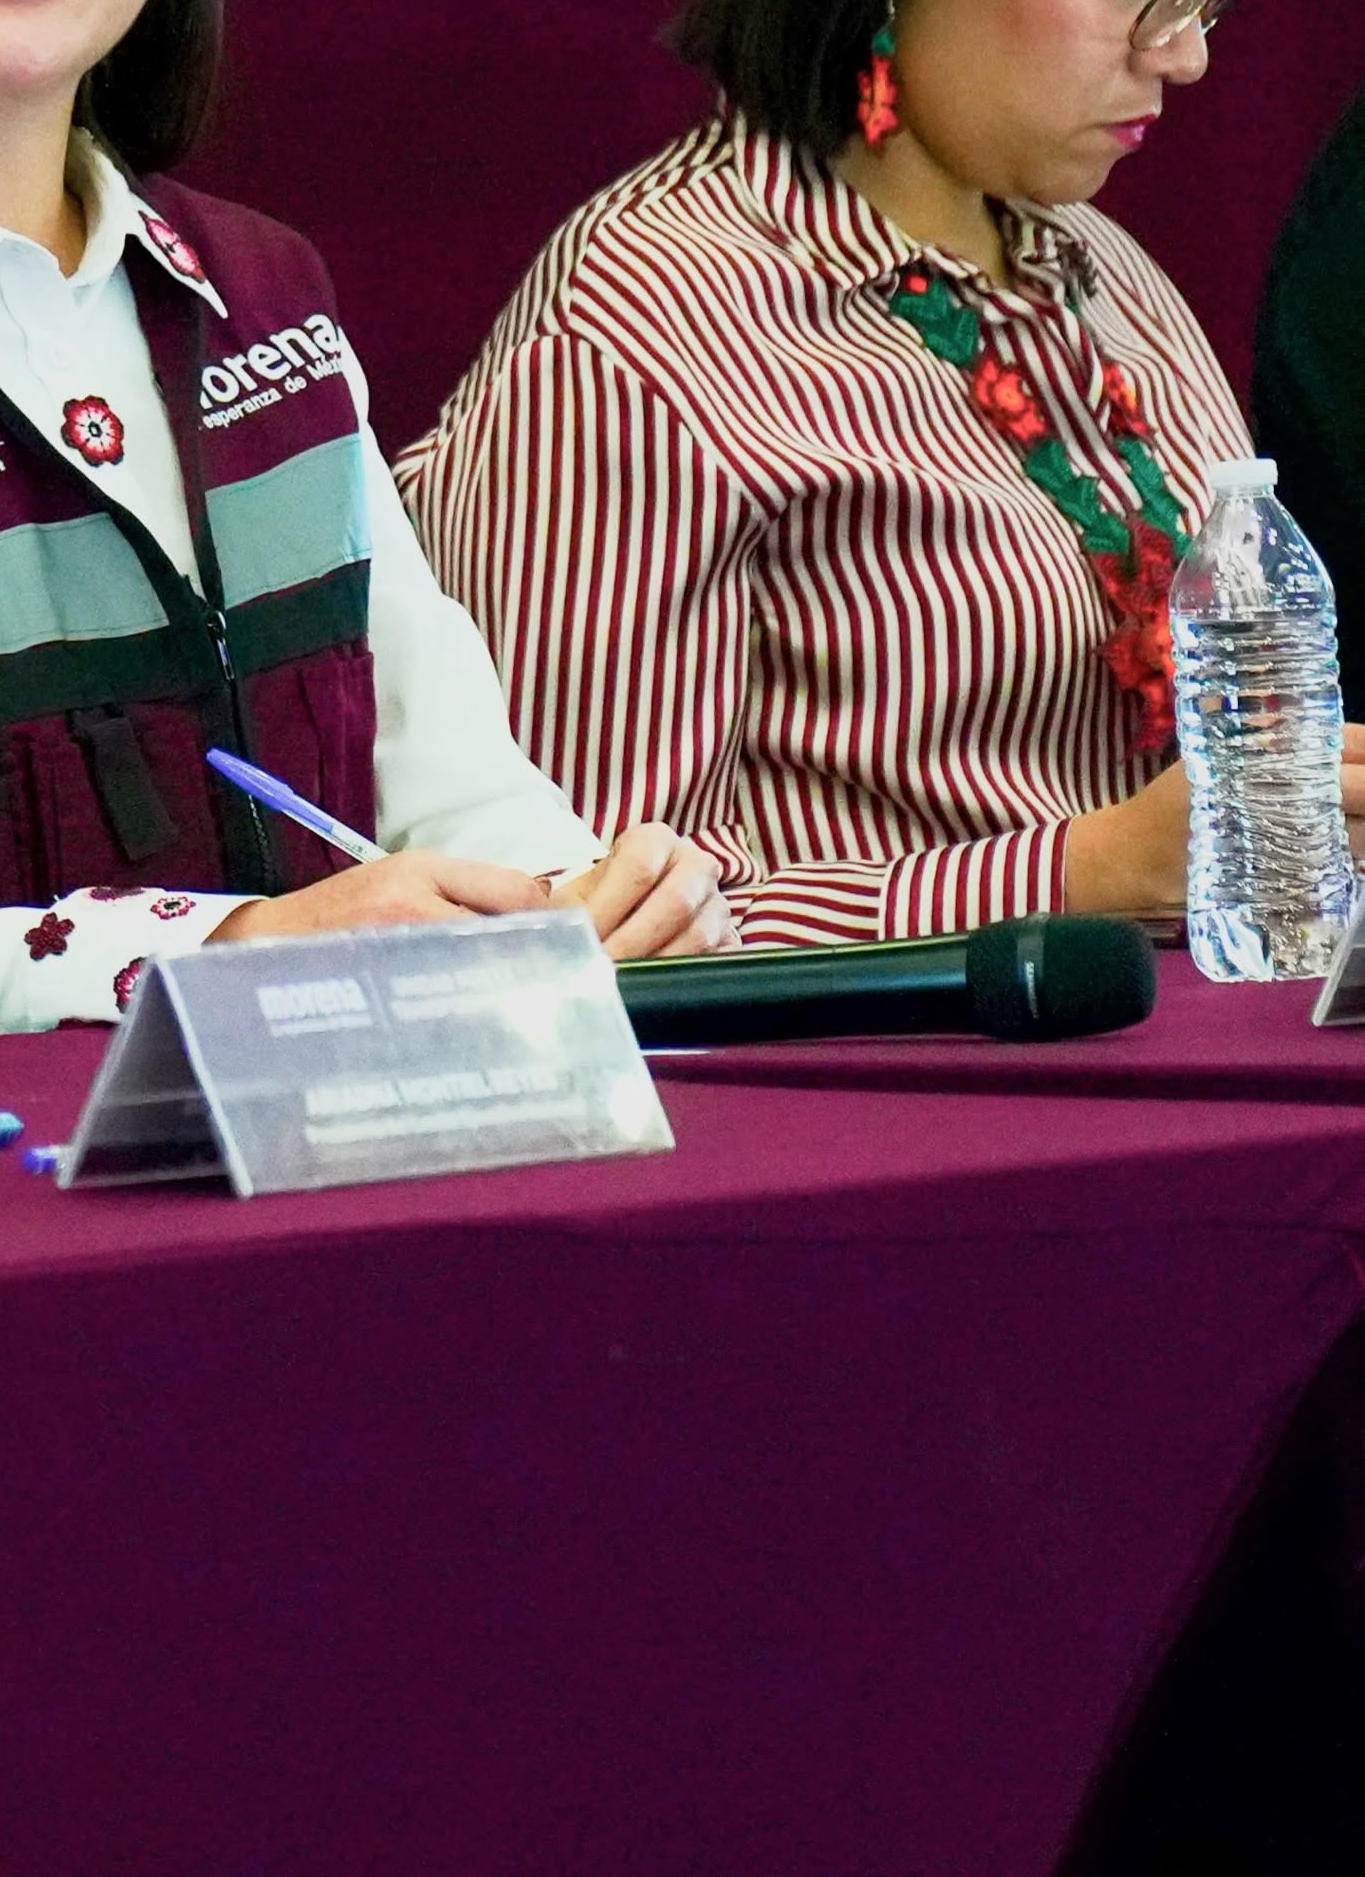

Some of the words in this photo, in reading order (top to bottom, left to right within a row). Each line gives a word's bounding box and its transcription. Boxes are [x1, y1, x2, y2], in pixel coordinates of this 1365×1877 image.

[199, 313, 340, 410] orena
[202, 387, 283, 429] esperanza
[283, 375, 307, 394] de
